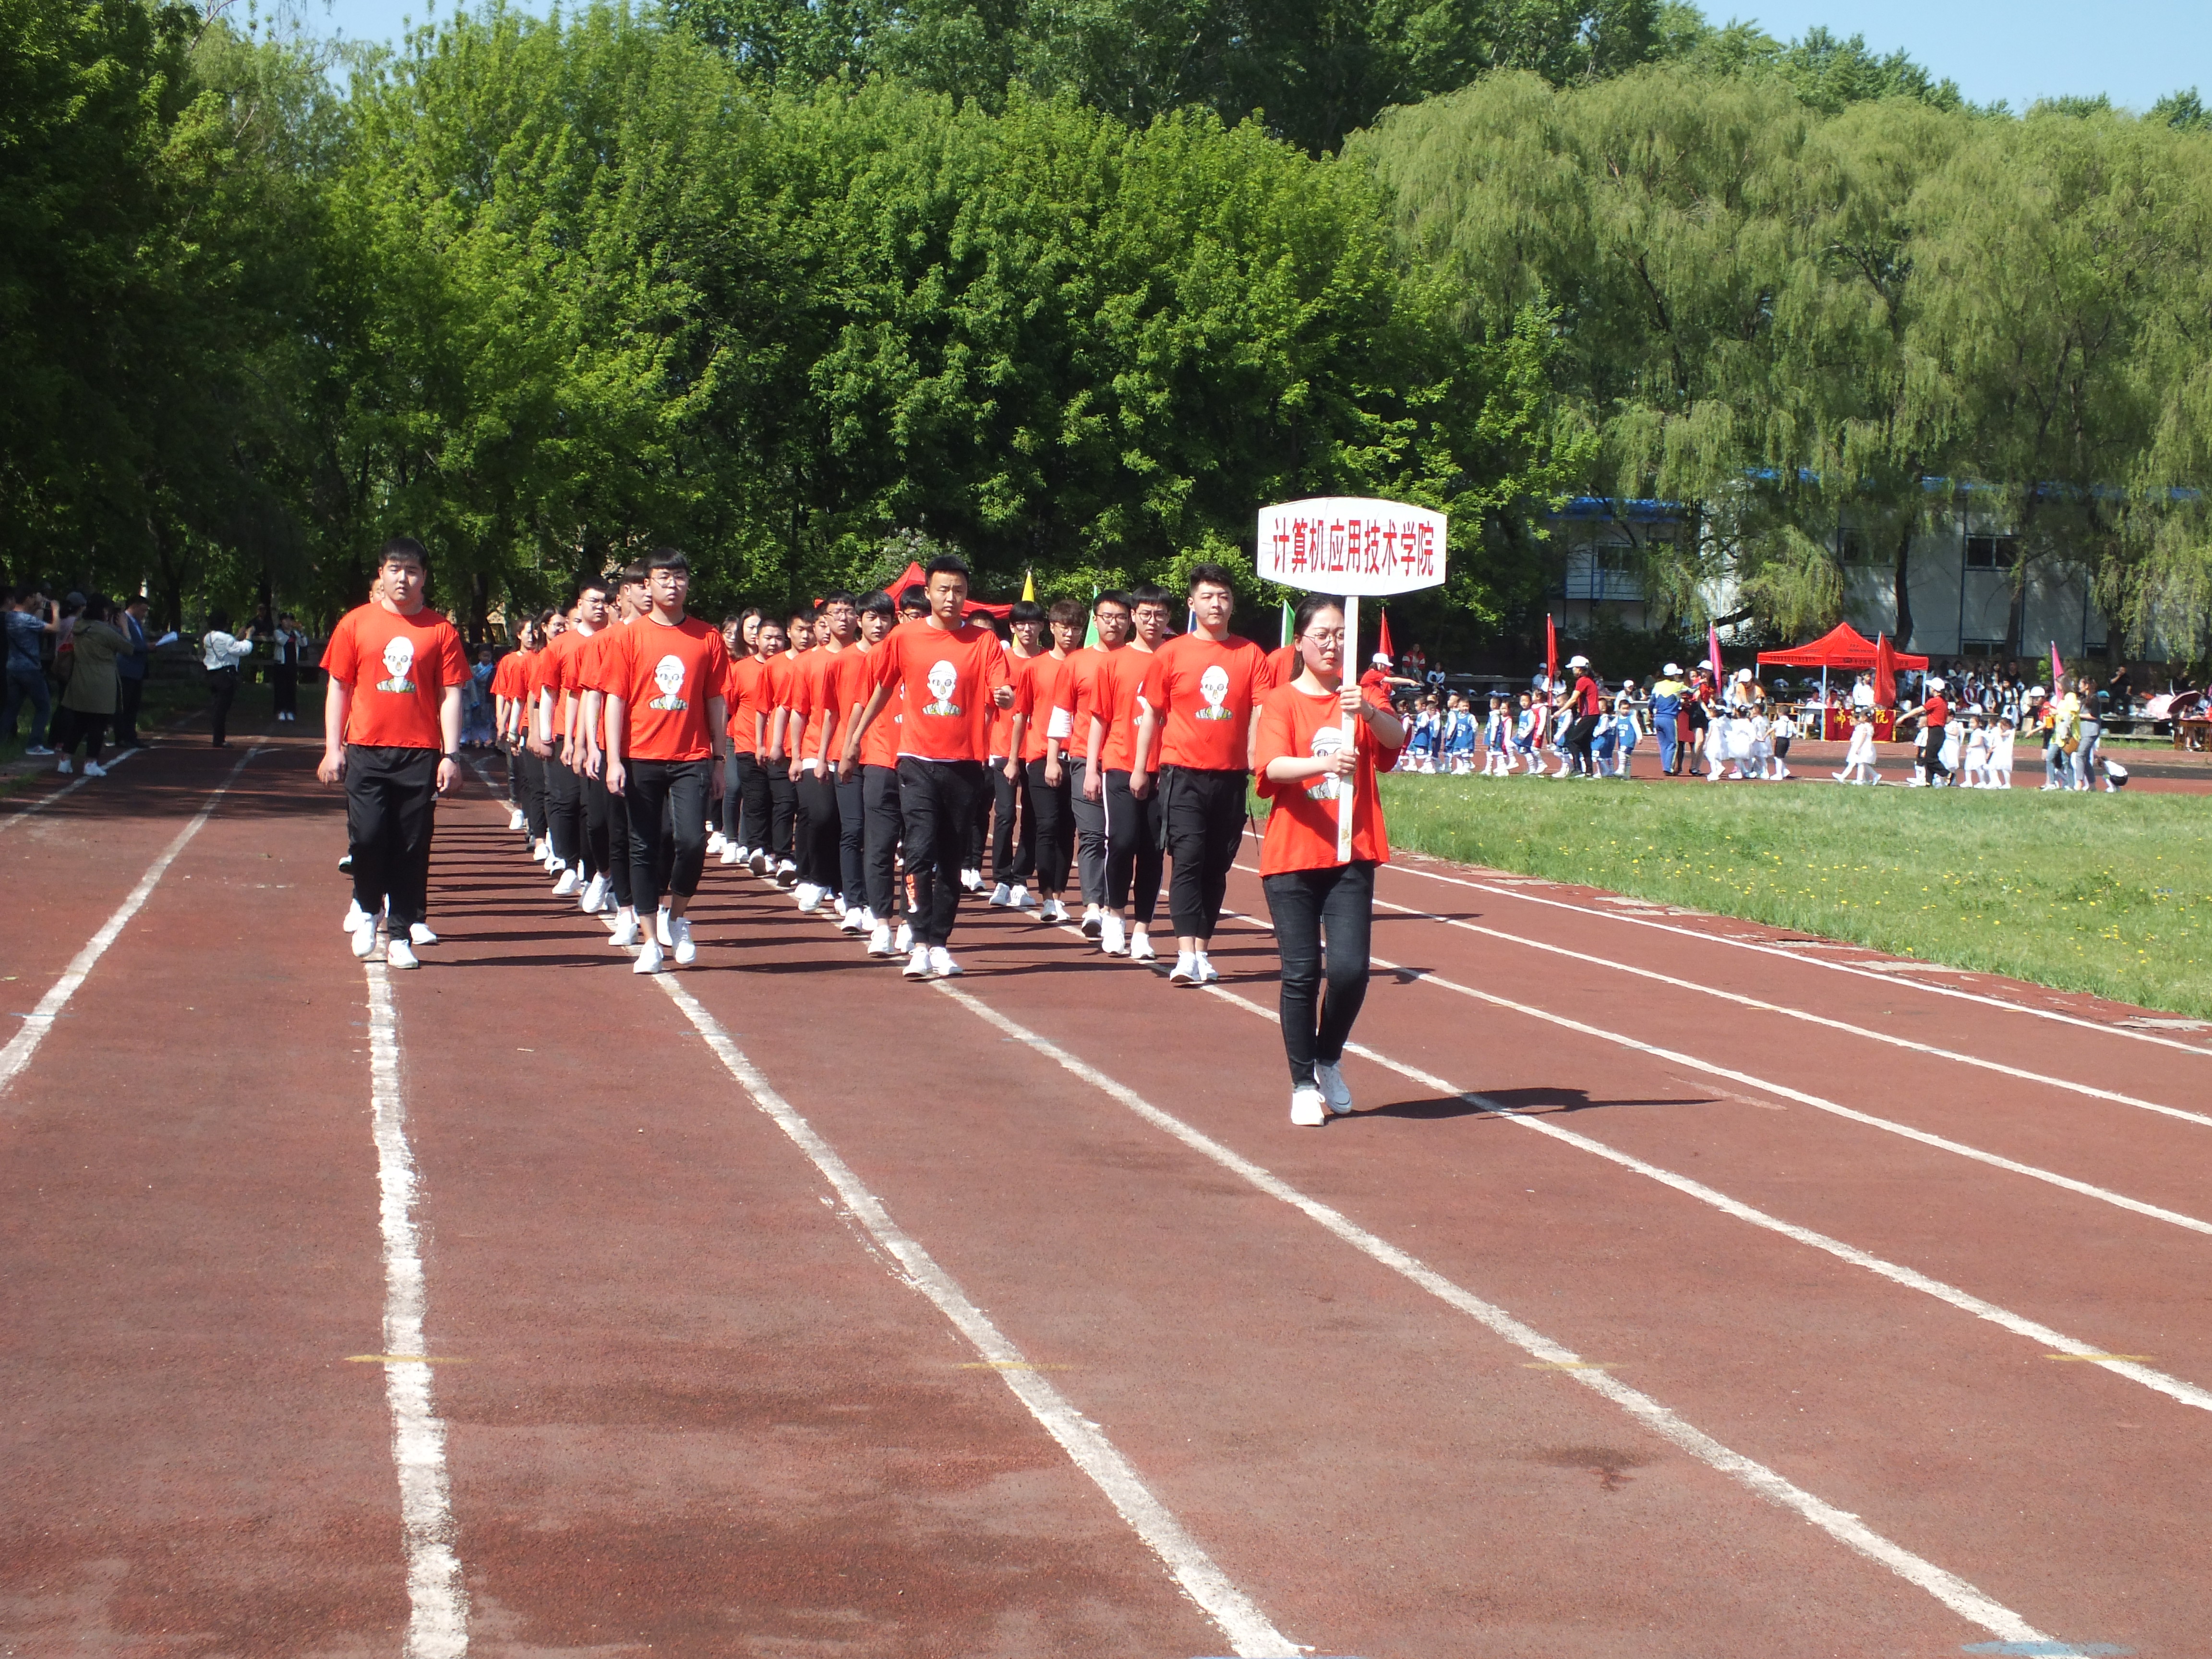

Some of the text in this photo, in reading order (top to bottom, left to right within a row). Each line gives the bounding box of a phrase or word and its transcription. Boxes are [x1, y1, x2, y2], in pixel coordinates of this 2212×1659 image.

[1273, 517, 1434, 577] 计算机应用技术学院
